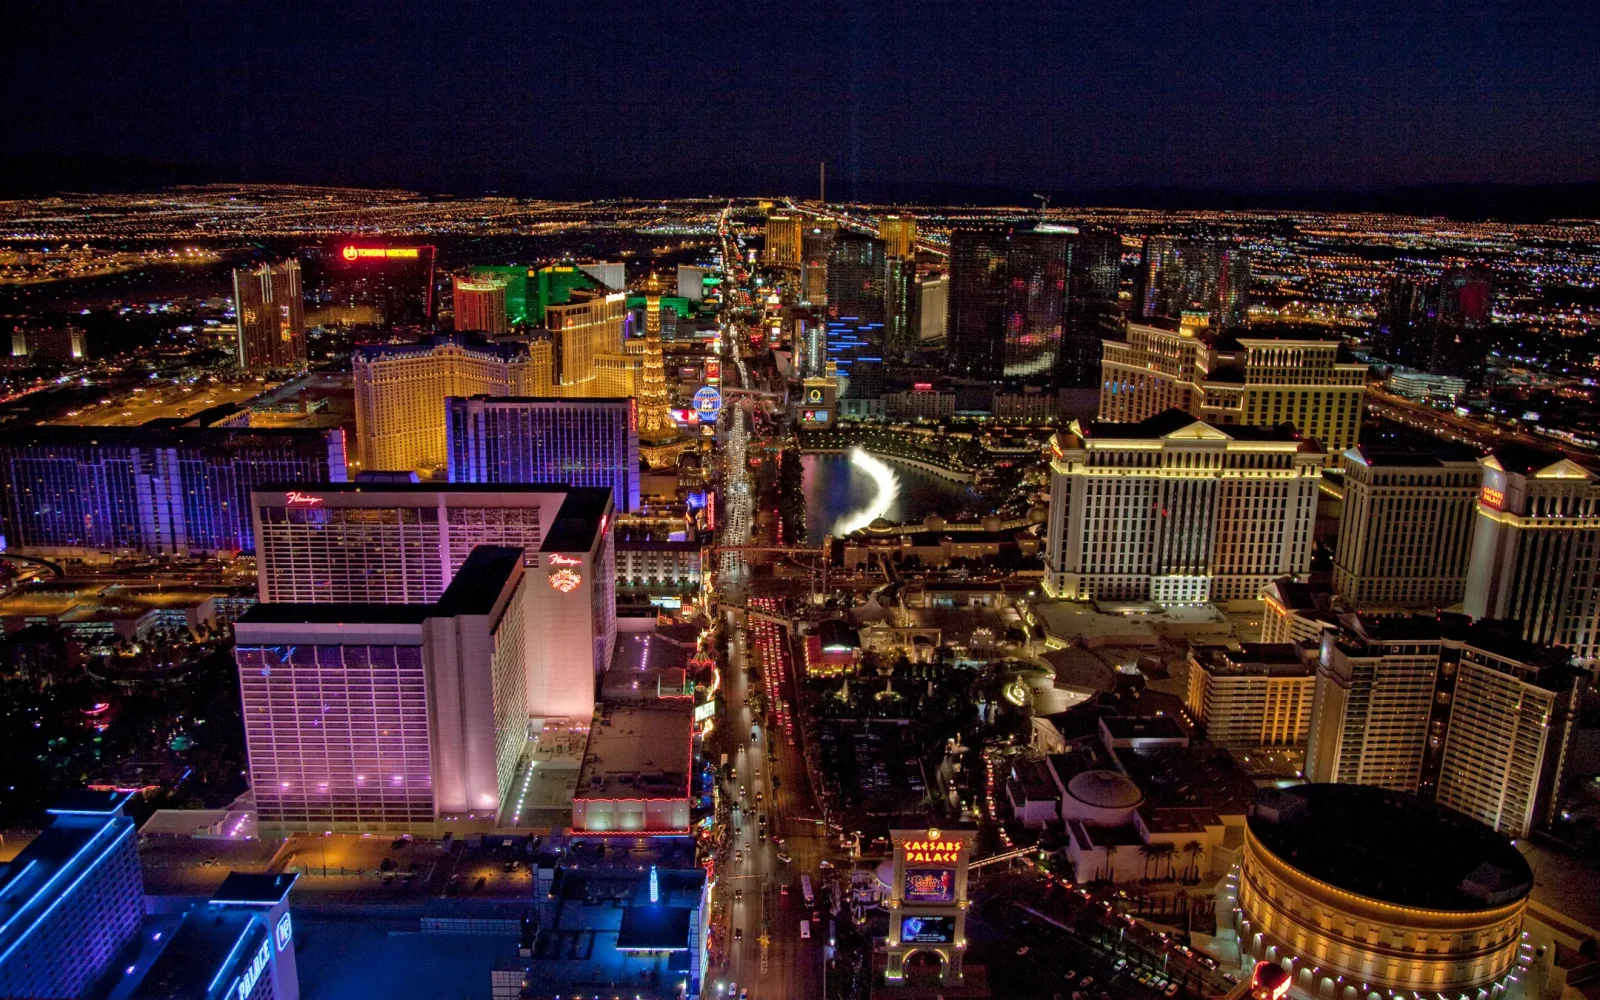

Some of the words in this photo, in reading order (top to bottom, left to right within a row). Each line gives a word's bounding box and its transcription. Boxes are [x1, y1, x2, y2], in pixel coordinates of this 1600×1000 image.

[358, 249, 386, 257] TOWERS
[386, 249, 418, 257] WESTGATE
[285, 492, 323, 505] Flamingo
[1483, 486, 1503, 500] CAESARS
[1483, 493, 1501, 507] PALACE
[549, 553, 582, 567] Flamingo
[904, 841, 961, 851] CAESARS
[906, 852, 958, 862] PALACE
[238, 938, 270, 1000] PALACE
